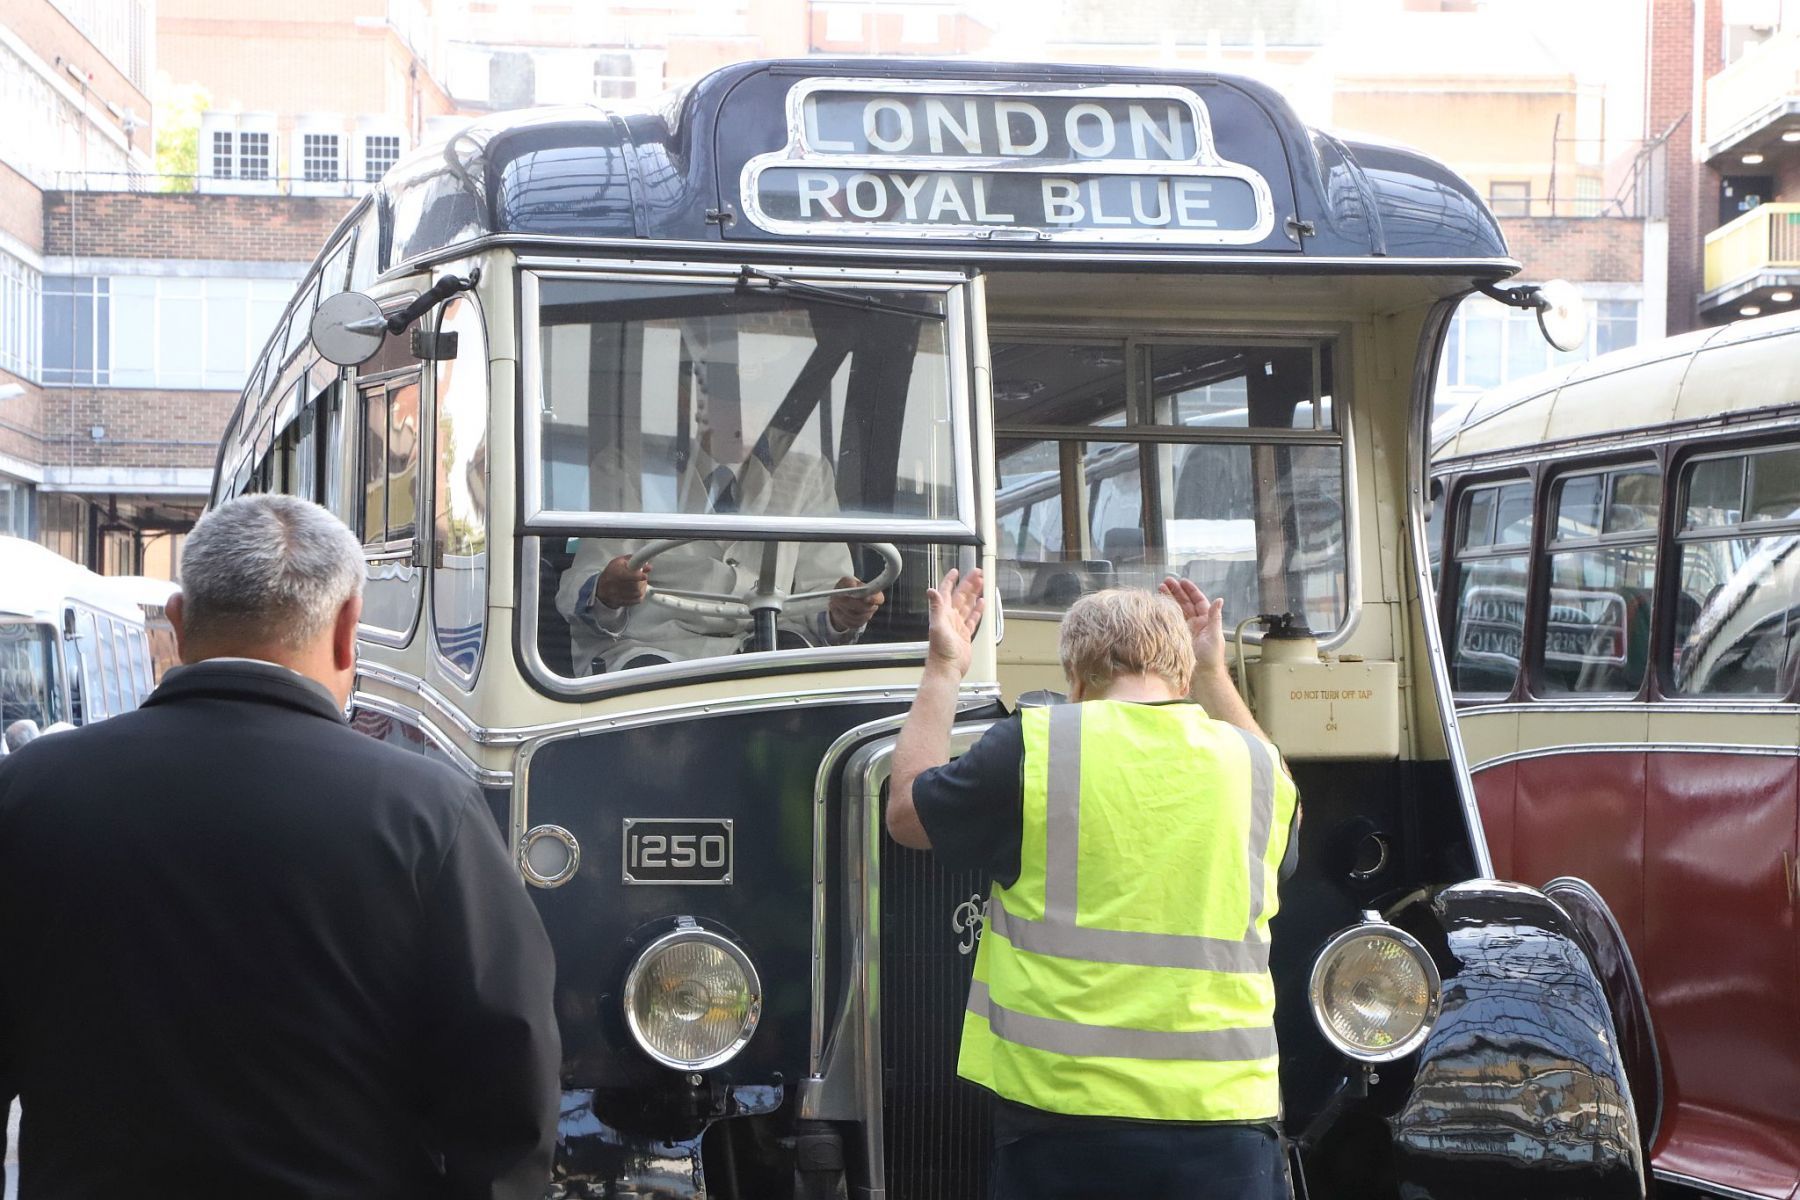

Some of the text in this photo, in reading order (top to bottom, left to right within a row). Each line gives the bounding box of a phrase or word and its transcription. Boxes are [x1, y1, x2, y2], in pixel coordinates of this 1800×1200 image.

[804, 97, 1186, 161] LONDON
[797, 173, 1218, 227] ROYAL BLUE
[1290, 690, 1373, 700] DO NOT TURN OFF TAP
[1325, 722, 1337, 732] ON
[631, 835, 725, 868] 1250
